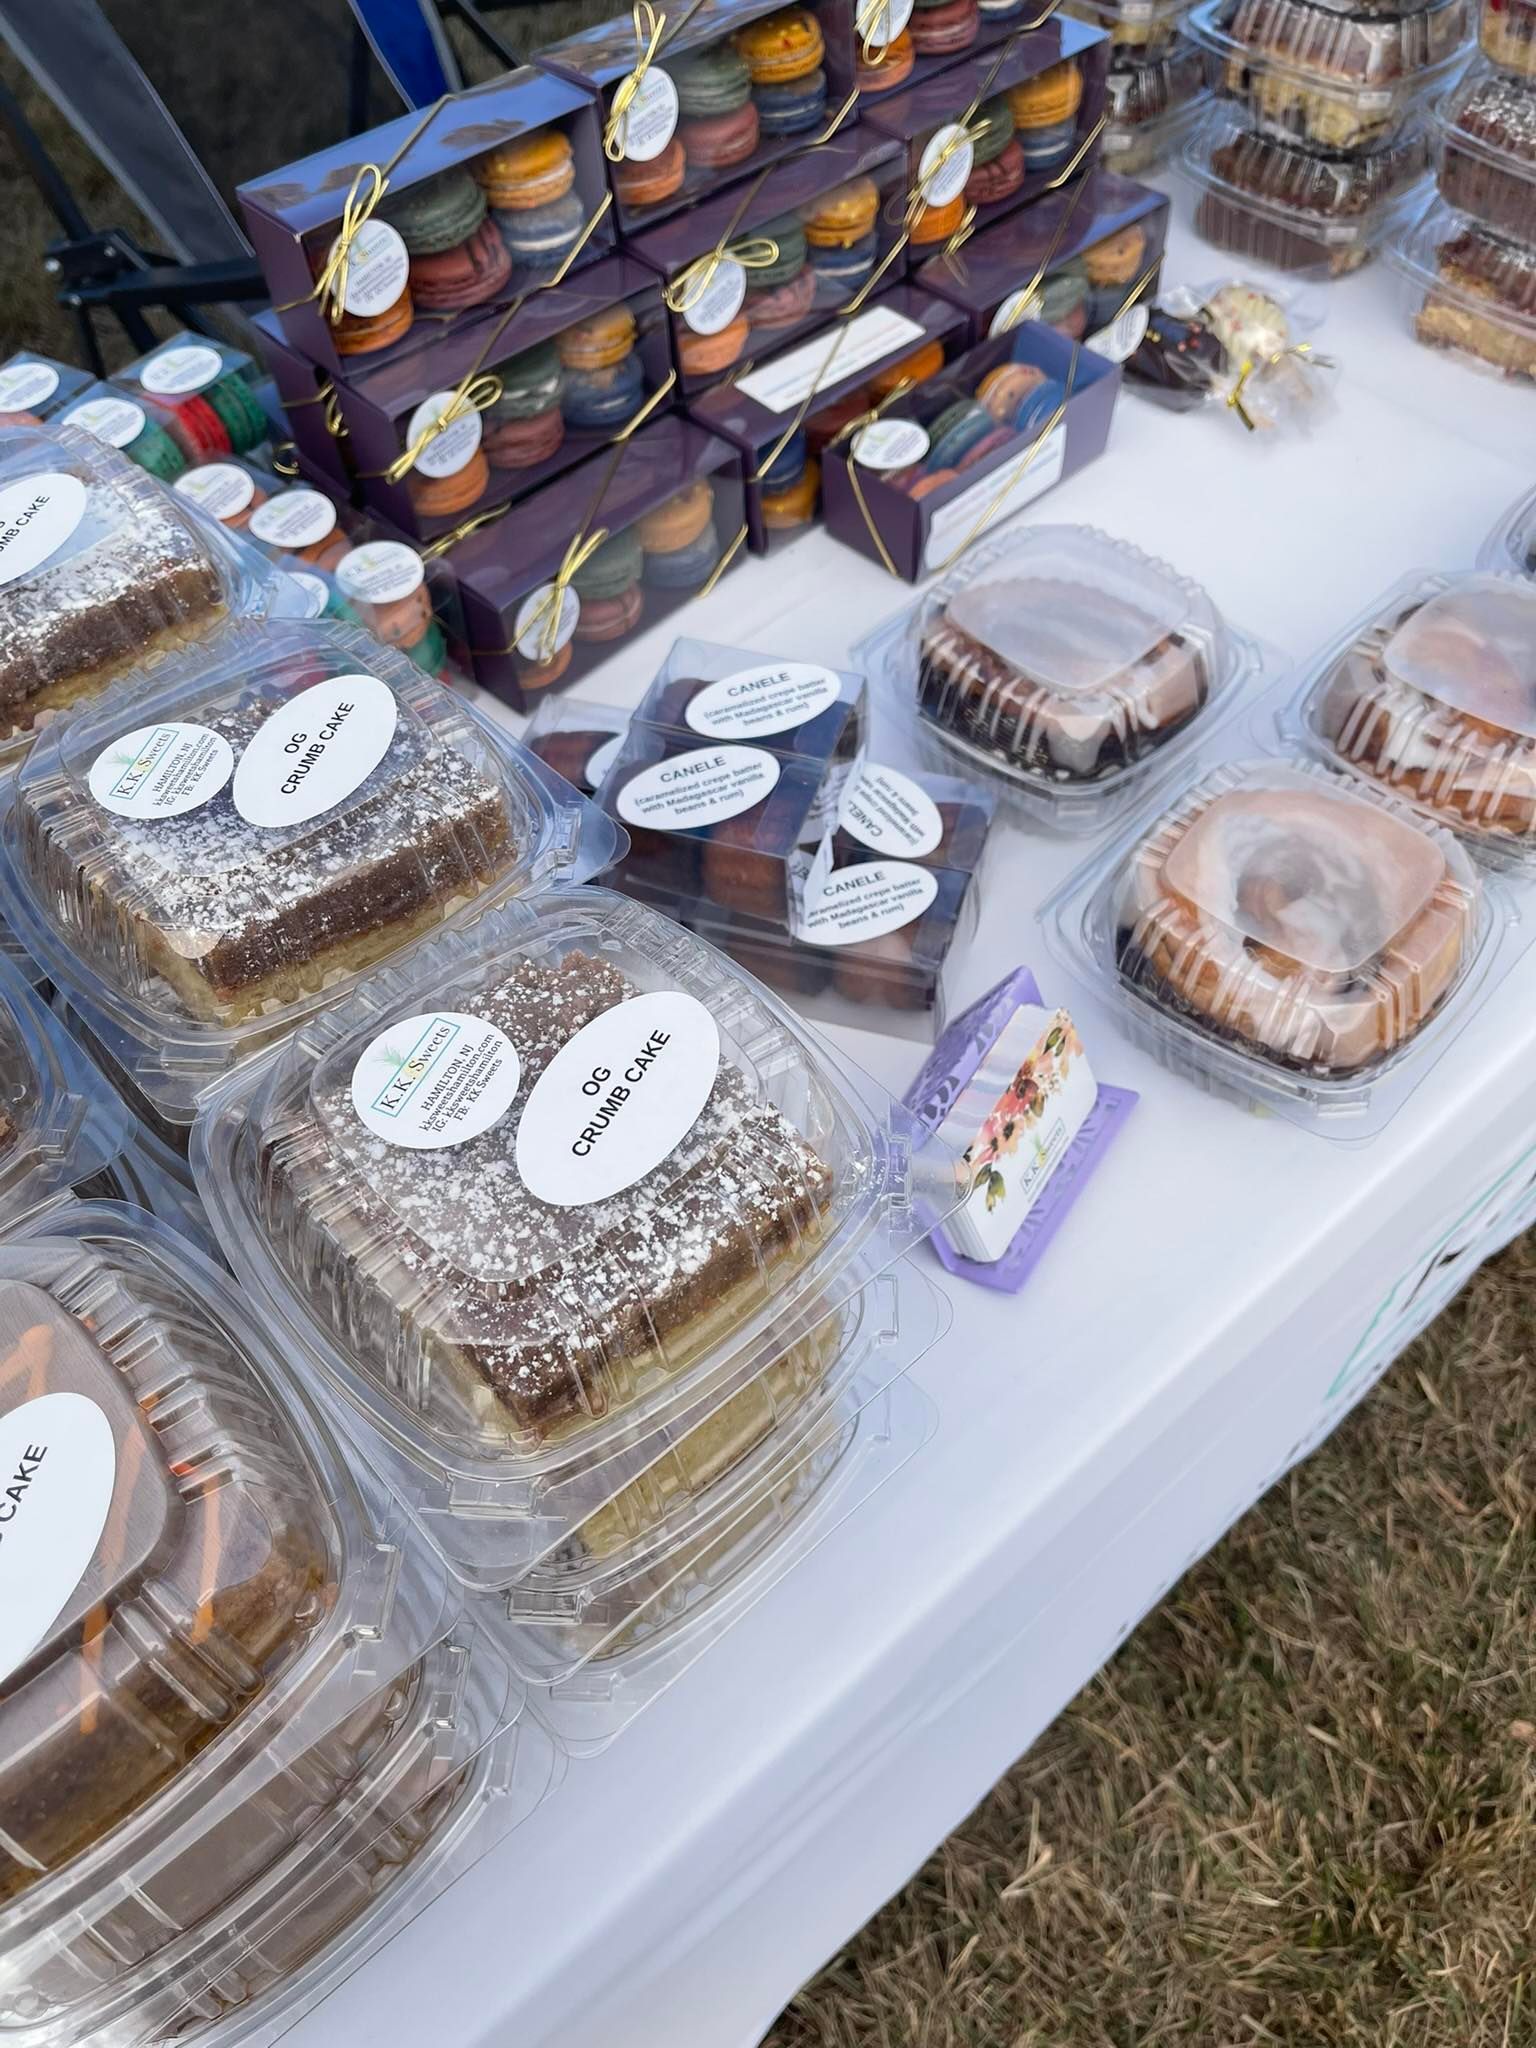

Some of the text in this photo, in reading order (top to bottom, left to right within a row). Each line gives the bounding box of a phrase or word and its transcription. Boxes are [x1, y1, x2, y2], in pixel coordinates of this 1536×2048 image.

[15, 495, 50, 526] CAKE
[727, 672, 791, 697] CANELE
[138, 732, 172, 767] Sweets
[181, 742, 194, 755] NJ
[280, 702, 355, 795] CRUMB CAKE
[283, 733, 308, 754] OG
[660, 755, 727, 783] CANELE
[847, 800, 883, 837] CANEL
[823, 870, 887, 897] CANELE
[380, 1025, 451, 1110] K.K. Sweets
[418, 1032, 495, 1132] kksweetshamilton.com
[420, 1043, 476, 1112] HAMILTON, NJ
[431, 1039, 504, 1133] IG: kksweetshamilton
[581, 1066, 611, 1096] OG
[454, 1057, 503, 1122] FB: KK Sweets
[571, 1029, 671, 1157] CRUMB CAKE
[0, 1444, 48, 1522] CAKE
